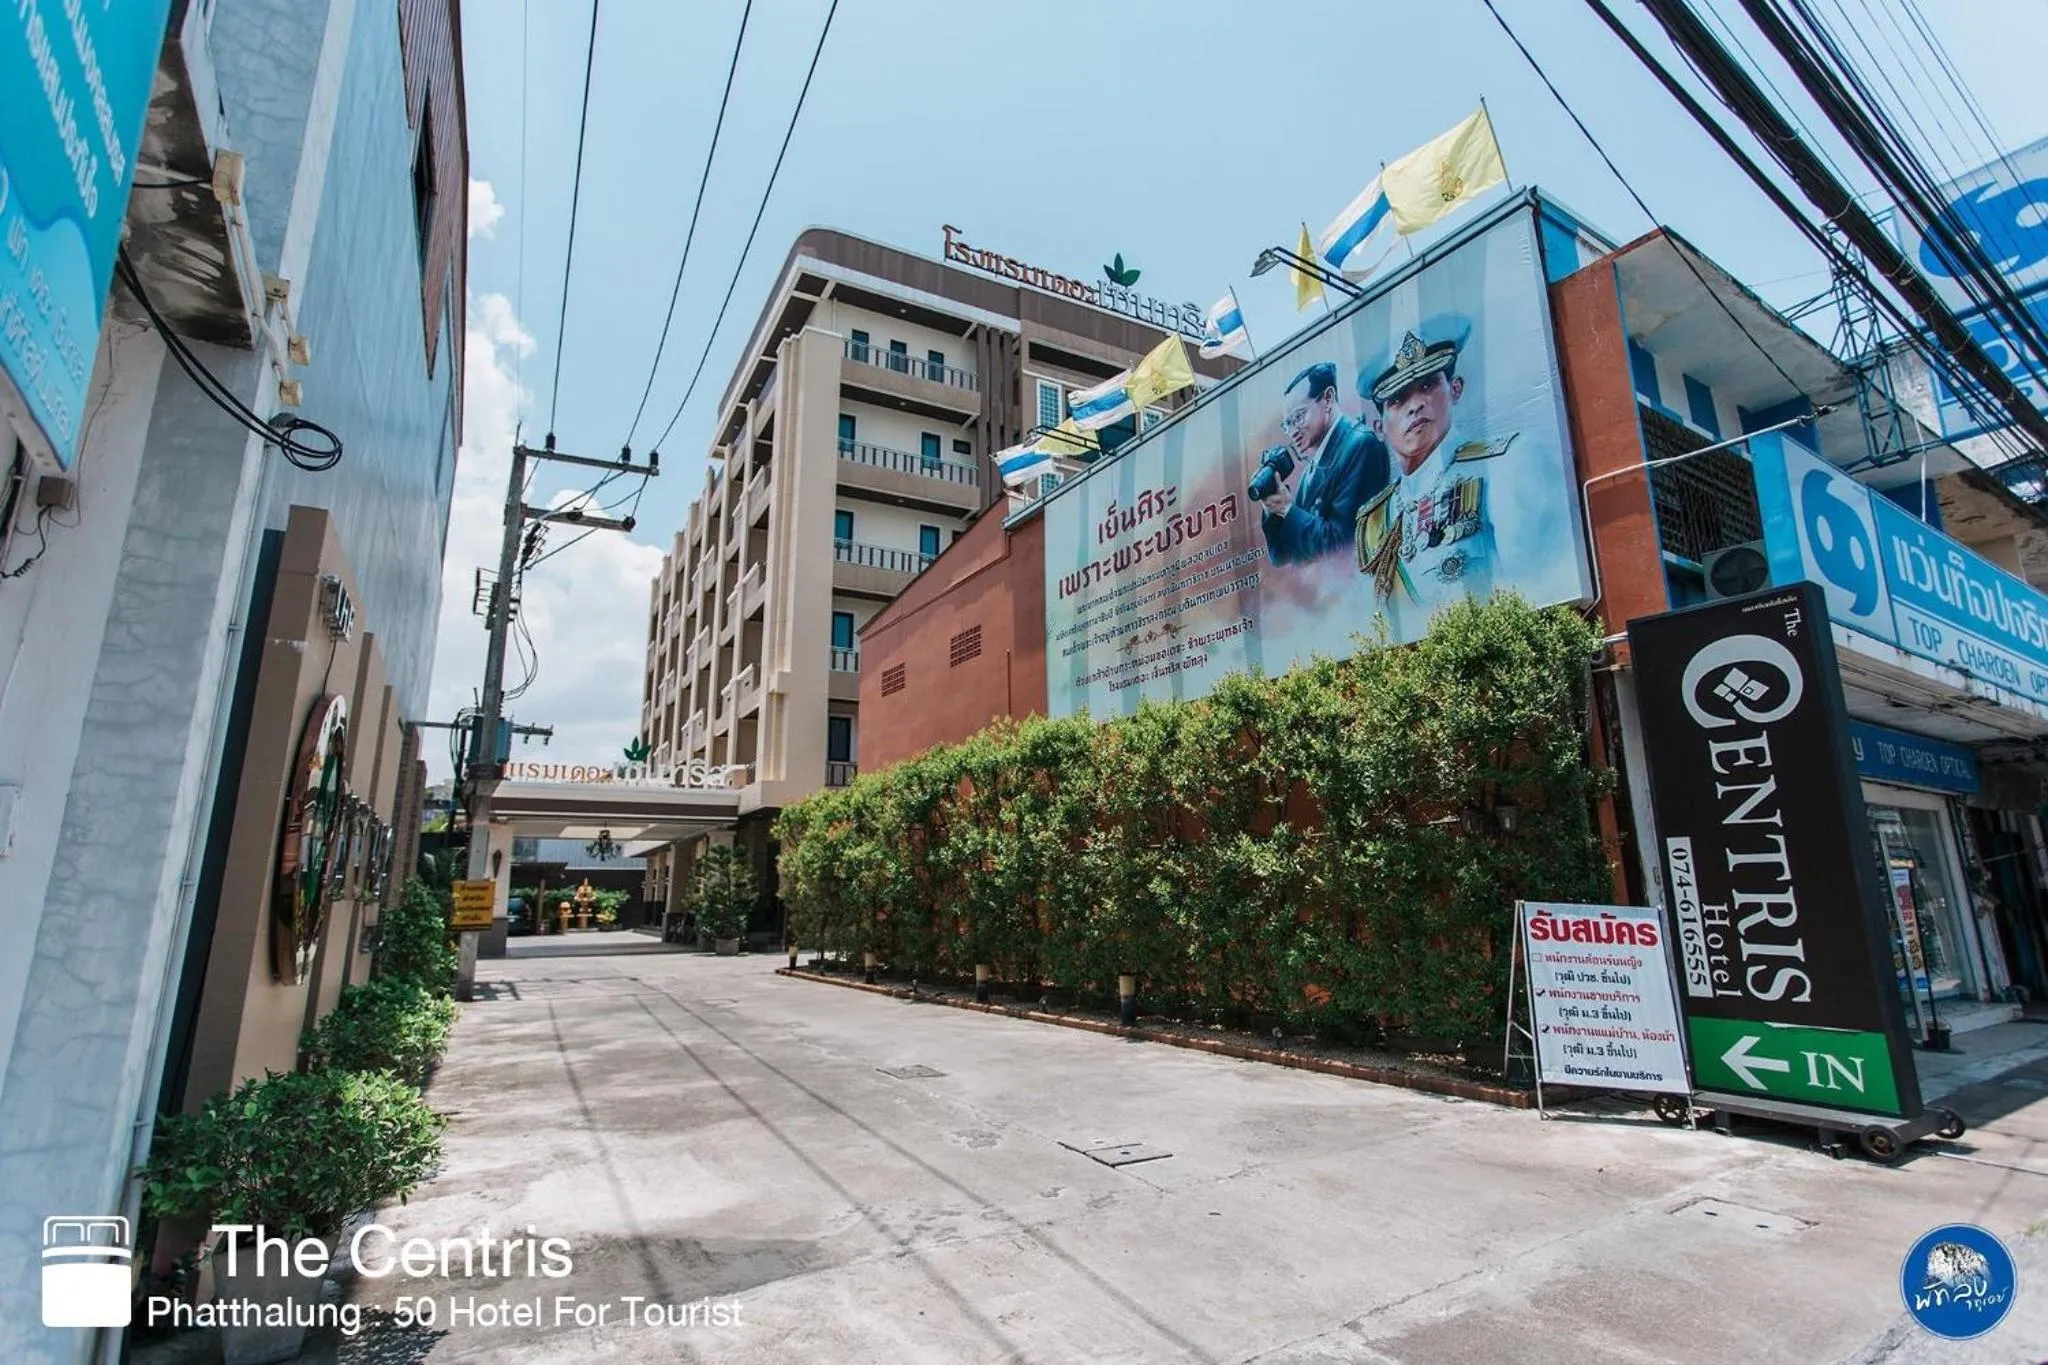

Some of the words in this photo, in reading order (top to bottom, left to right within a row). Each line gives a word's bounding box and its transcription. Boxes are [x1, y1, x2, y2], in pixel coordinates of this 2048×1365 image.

[1097, 485, 1177, 545] เย็นศิระ
[1058, 494, 1238, 600] เพราะพระบริบาล
[1784, 608, 1802, 637] The
[1908, 617, 1942, 652] TOP
[1957, 640, 2021, 685] CHAROEN
[1877, 741, 1896, 765] TOP
[1681, 634, 1812, 1004] CENTRIS
[1530, 910, 1659, 947] รับสมัคร
[1671, 846, 1708, 986] 074-616555
[1544, 952, 1643, 970] พนักงานต้อนรับหญิง
[1703, 901, 1743, 998] Hotel
[1800, 1050, 1865, 1095] IN
